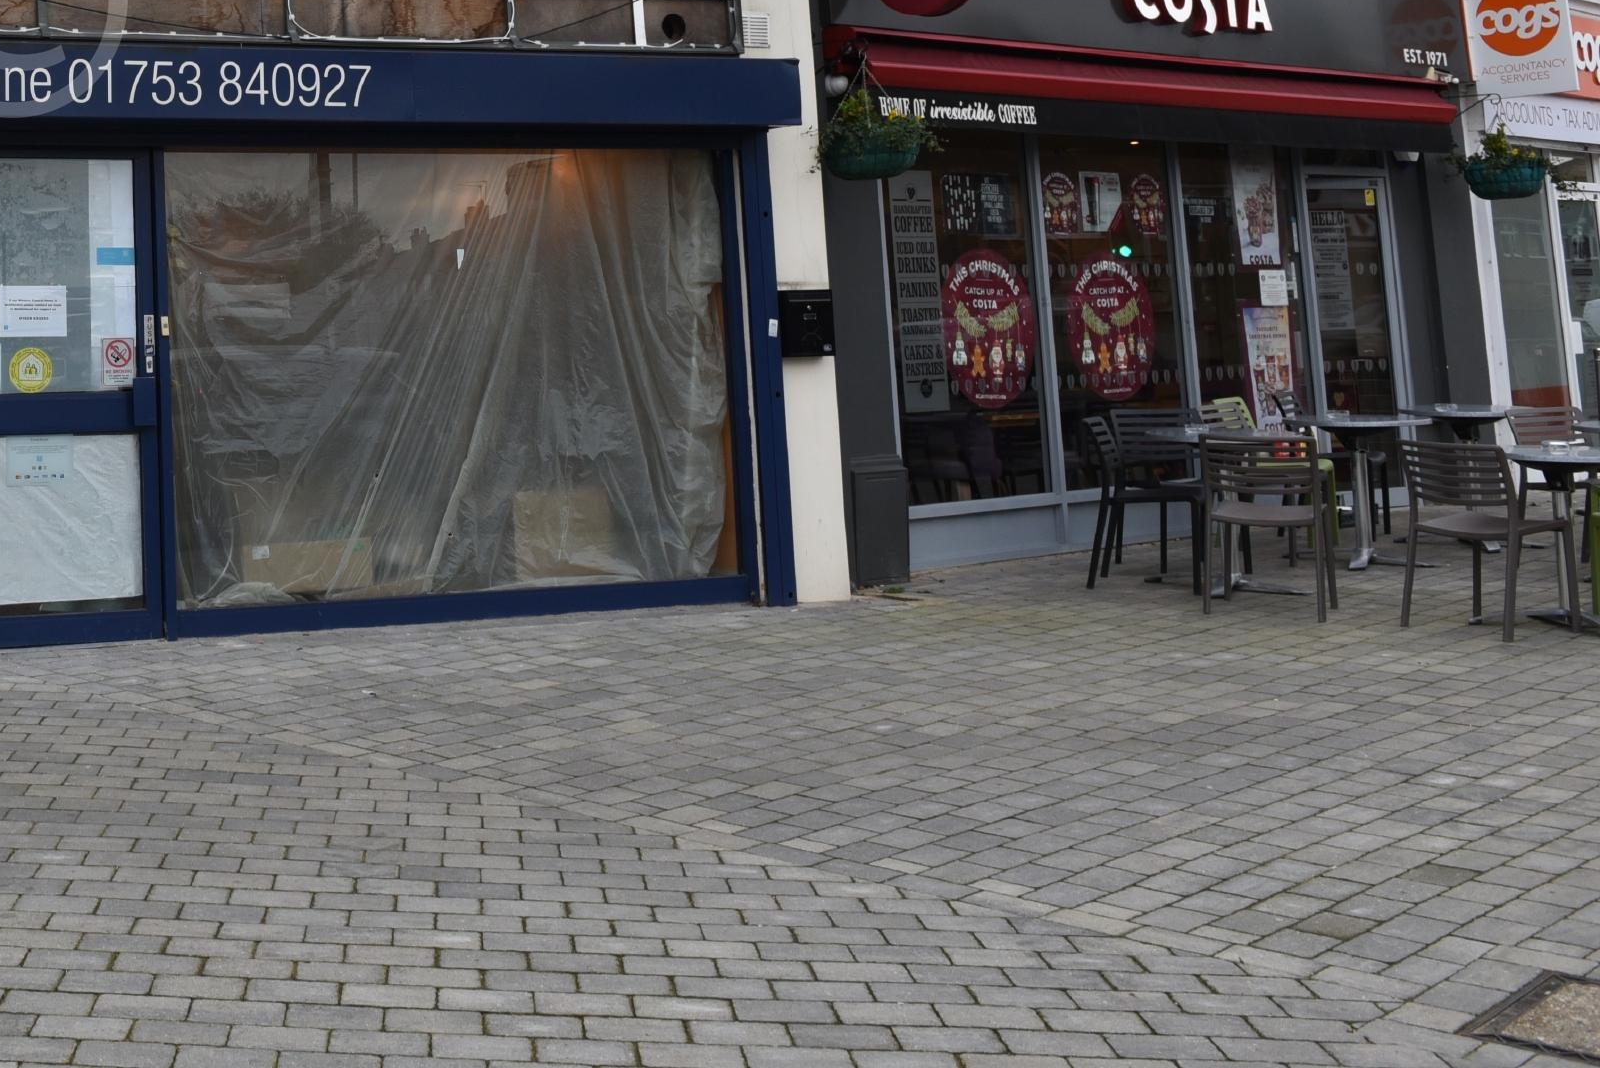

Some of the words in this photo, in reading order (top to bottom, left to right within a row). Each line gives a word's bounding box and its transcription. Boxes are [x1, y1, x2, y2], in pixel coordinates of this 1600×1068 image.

[1476, 1, 1560, 40] cogs
[1403, 48, 1424, 65] EST.
[1425, 51, 1448, 67] 1971
[1481, 58, 1567, 76] ACCOUNTANCY
[68, 58, 202, 106] 01753
[218, 61, 372, 107] 840927
[1500, 70, 1550, 84] SERVICES
[878, 96, 911, 118] HOME
[913, 98, 927, 119] OF
[930, 99, 996, 122] irresistible
[997, 103, 1038, 125] COFFEE
[1499, 101, 1553, 127] ACCOUNTS
[1562, 108, 1581, 129] TAX
[894, 216, 934, 233] COFFEE
[1311, 211, 1344, 226] HELLO
[896, 242, 914, 254] ICED
[916, 242, 935, 254] COLD
[897, 257, 936, 273] DRINKS
[1249, 254, 1274, 265] COSTA
[949, 266, 969, 292] THIS
[968, 259, 1020, 296] CHRISTMAS
[1075, 269, 1092, 294] THIS
[1091, 260, 1139, 292] CHRISTMAS
[899, 282, 938, 298] PANINIS
[964, 286, 985, 295] CATCH
[986, 287, 995, 295] UP
[996, 287, 1004, 295] AT
[1088, 286, 1107, 295] CATCH
[1108, 286, 1117, 294] UP
[1117, 286, 1124, 294] AT
[972, 298, 998, 310] COSTA
[1096, 298, 1119, 308] COSTA
[901, 308, 940, 323] TOASTED
[904, 344, 934, 361] CAKES
[935, 344, 943, 359] &
[905, 362, 945, 377] PASTRIES
